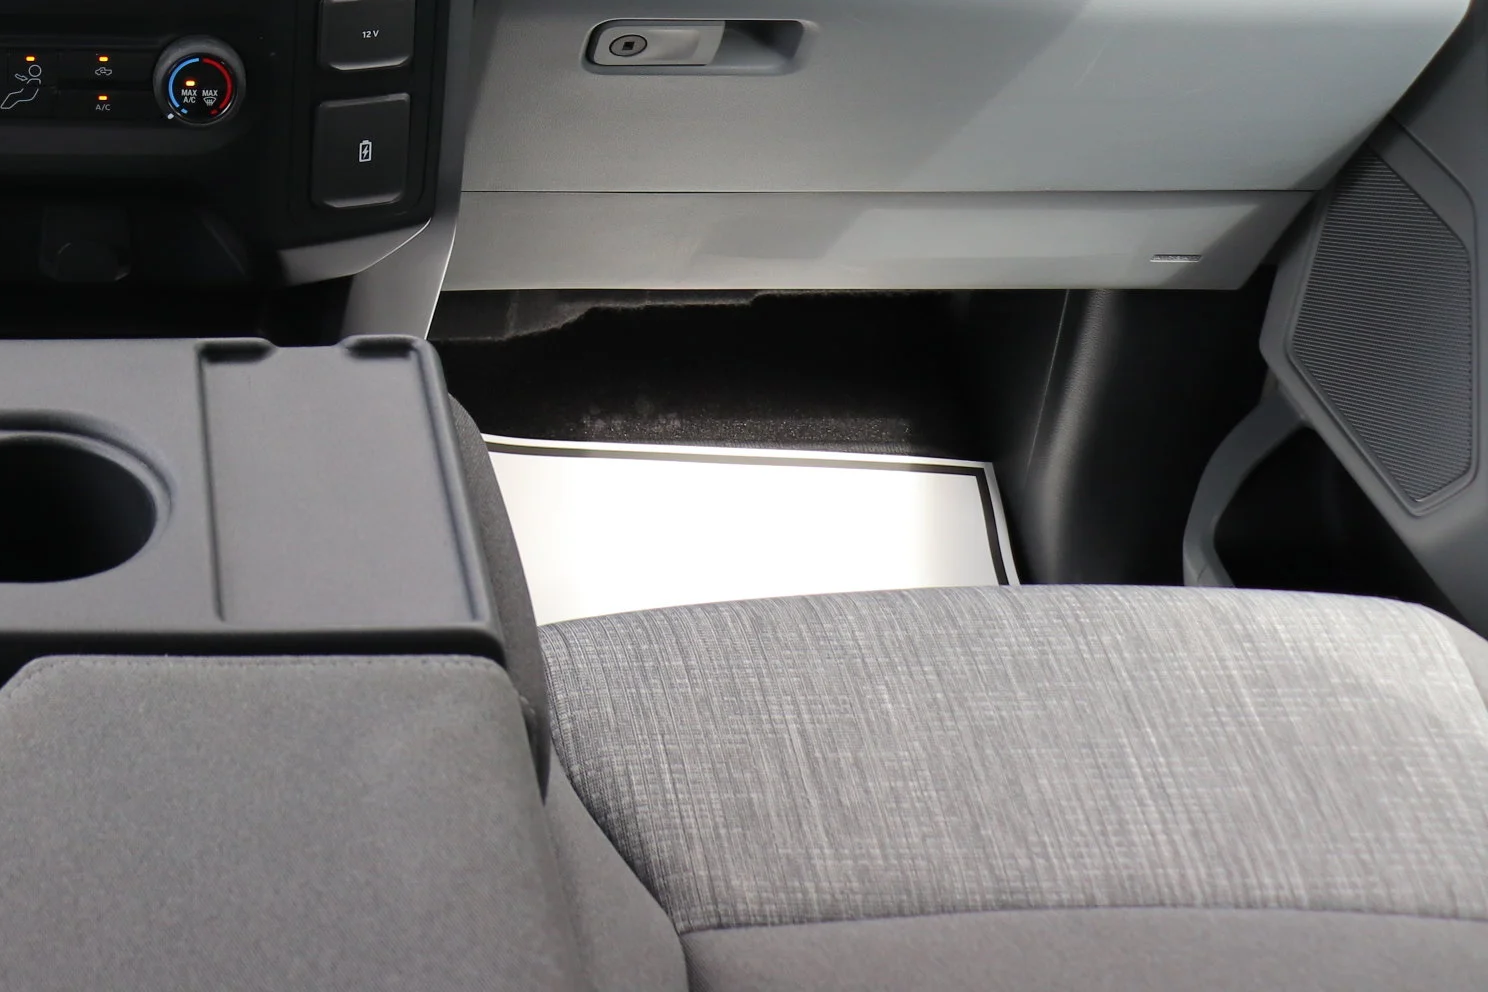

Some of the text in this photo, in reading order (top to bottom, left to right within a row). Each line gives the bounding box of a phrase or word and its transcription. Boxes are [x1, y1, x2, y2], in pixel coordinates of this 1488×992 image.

[202, 89, 218, 97] MAX
[183, 96, 196, 104] A/C
[95, 103, 111, 111] A/C
